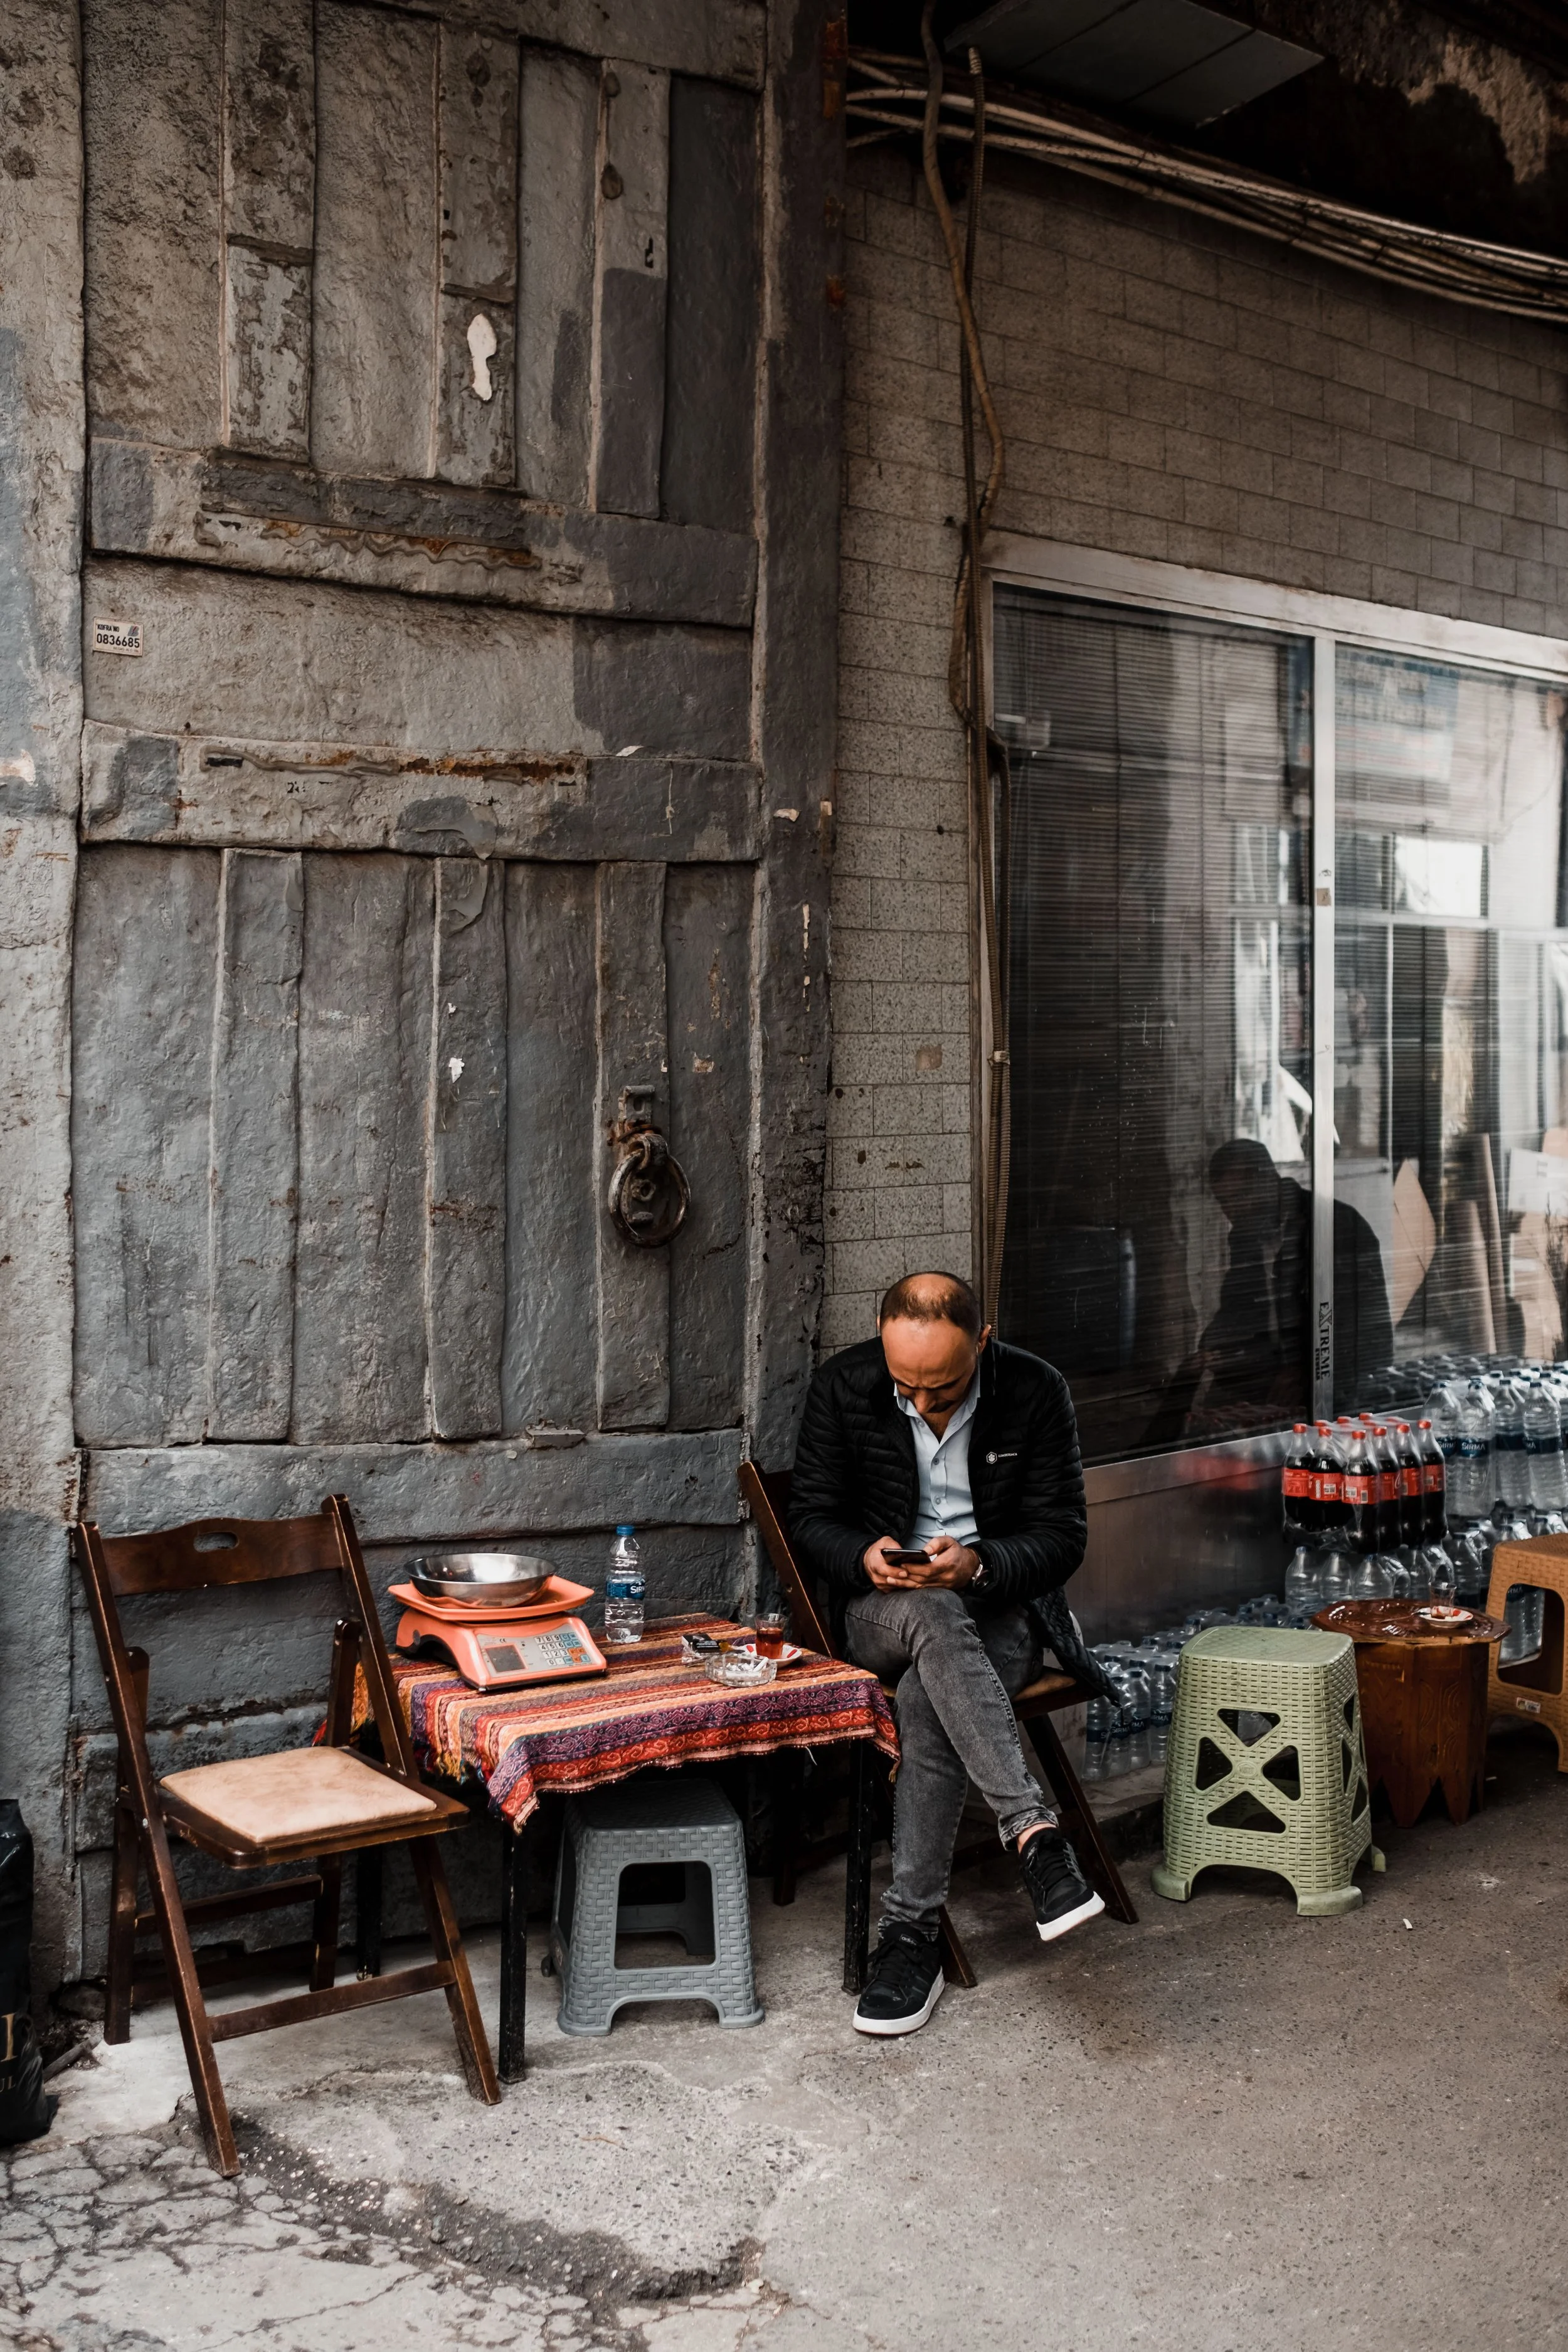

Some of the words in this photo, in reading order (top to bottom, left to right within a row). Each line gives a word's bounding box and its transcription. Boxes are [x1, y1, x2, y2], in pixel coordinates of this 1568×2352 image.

[97, 633, 140, 648] 0836685
[1319, 1301, 1333, 1379] EXTREME
[1461, 1442, 1486, 1451] SIRMA
